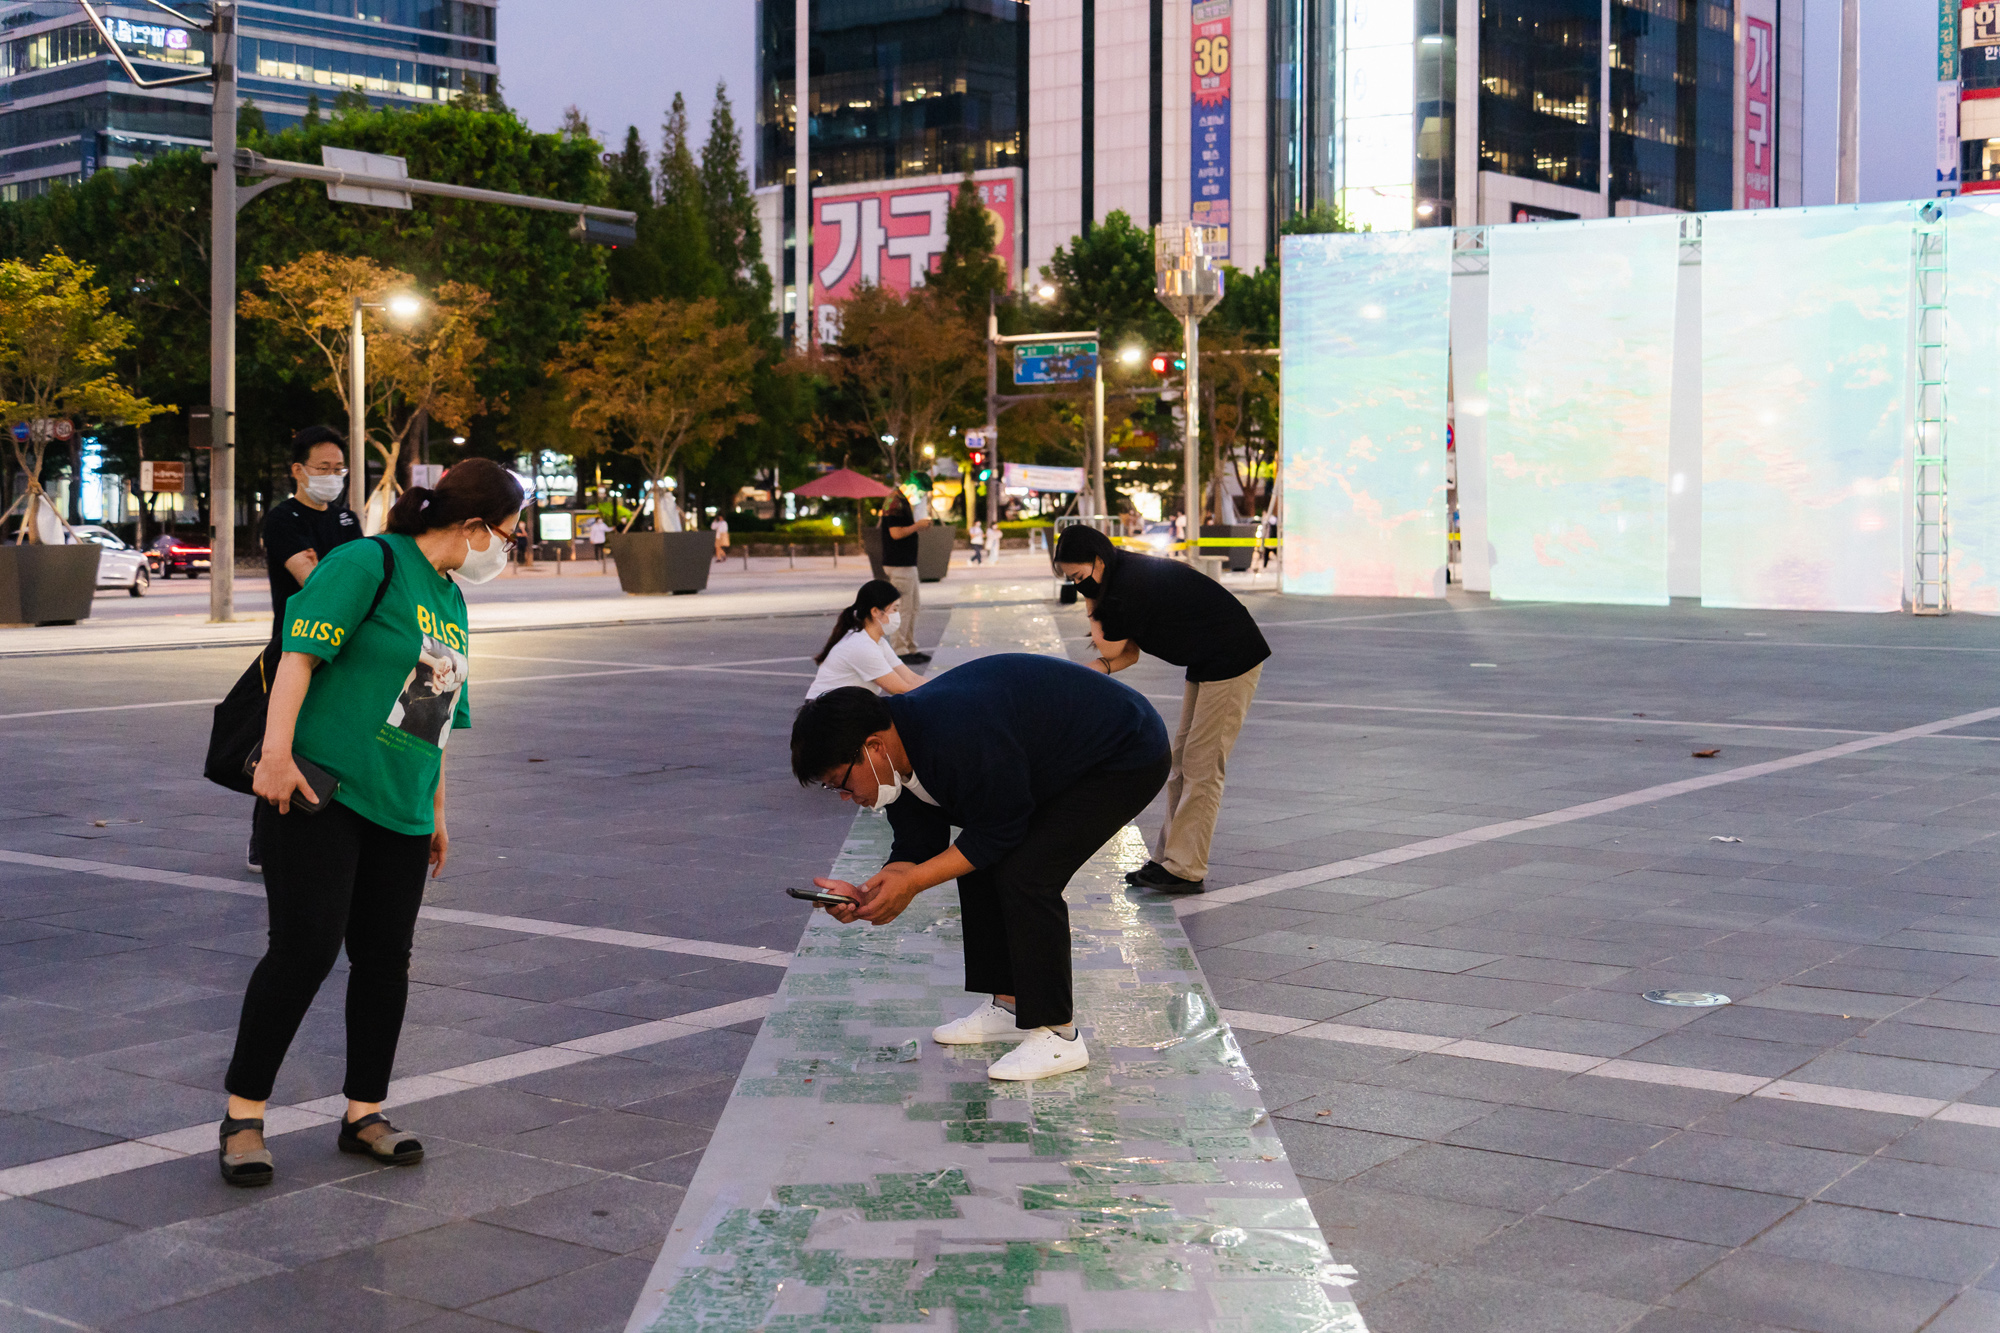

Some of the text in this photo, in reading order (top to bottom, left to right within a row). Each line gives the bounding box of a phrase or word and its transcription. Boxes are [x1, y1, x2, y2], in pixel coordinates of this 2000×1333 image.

[1194, 35, 1229, 76] 36
[1985, 46, 2000, 61] 한
[1748, 26, 1769, 168] 가구
[819, 191, 950, 290] 가구
[291, 618, 345, 646] BLISS
[418, 605, 467, 657] BLISS
